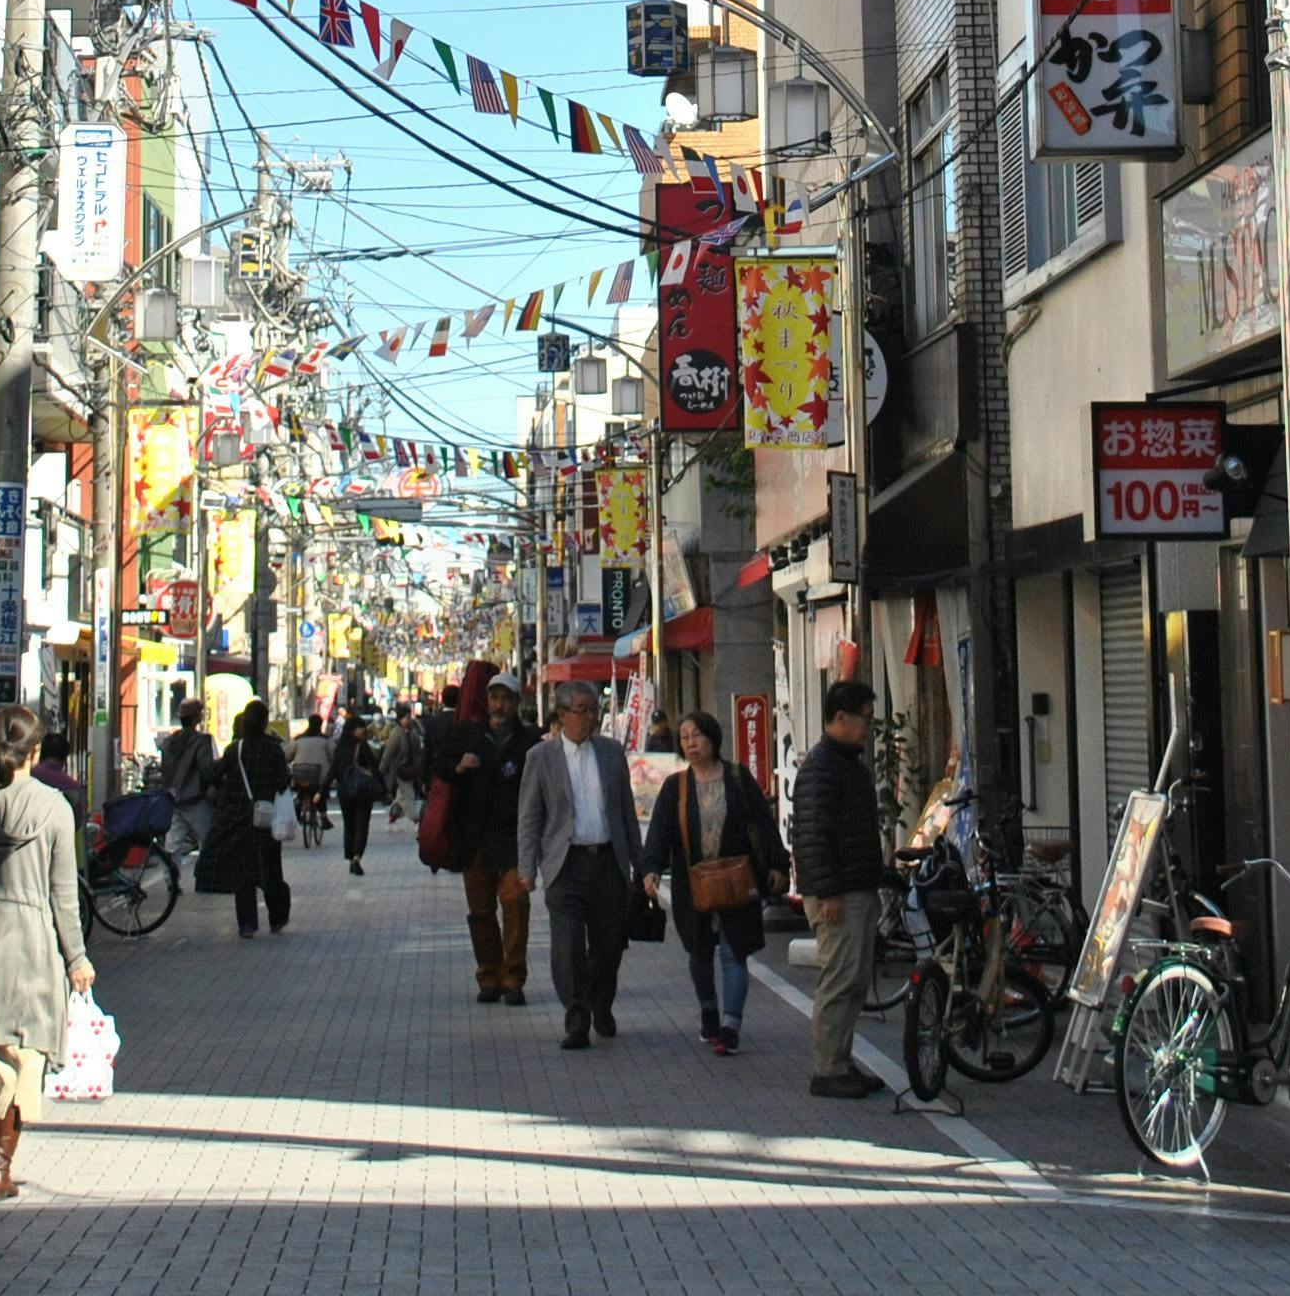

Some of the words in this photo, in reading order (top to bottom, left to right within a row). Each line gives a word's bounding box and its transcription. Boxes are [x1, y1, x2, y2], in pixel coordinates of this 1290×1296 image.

[94, 150, 108, 216] セントラル
[771, 299, 801, 402] 秋まつり
[1103, 419, 1217, 458] お惣菜
[1106, 480, 1180, 522] 100
[611, 570, 624, 631] PRONTO
